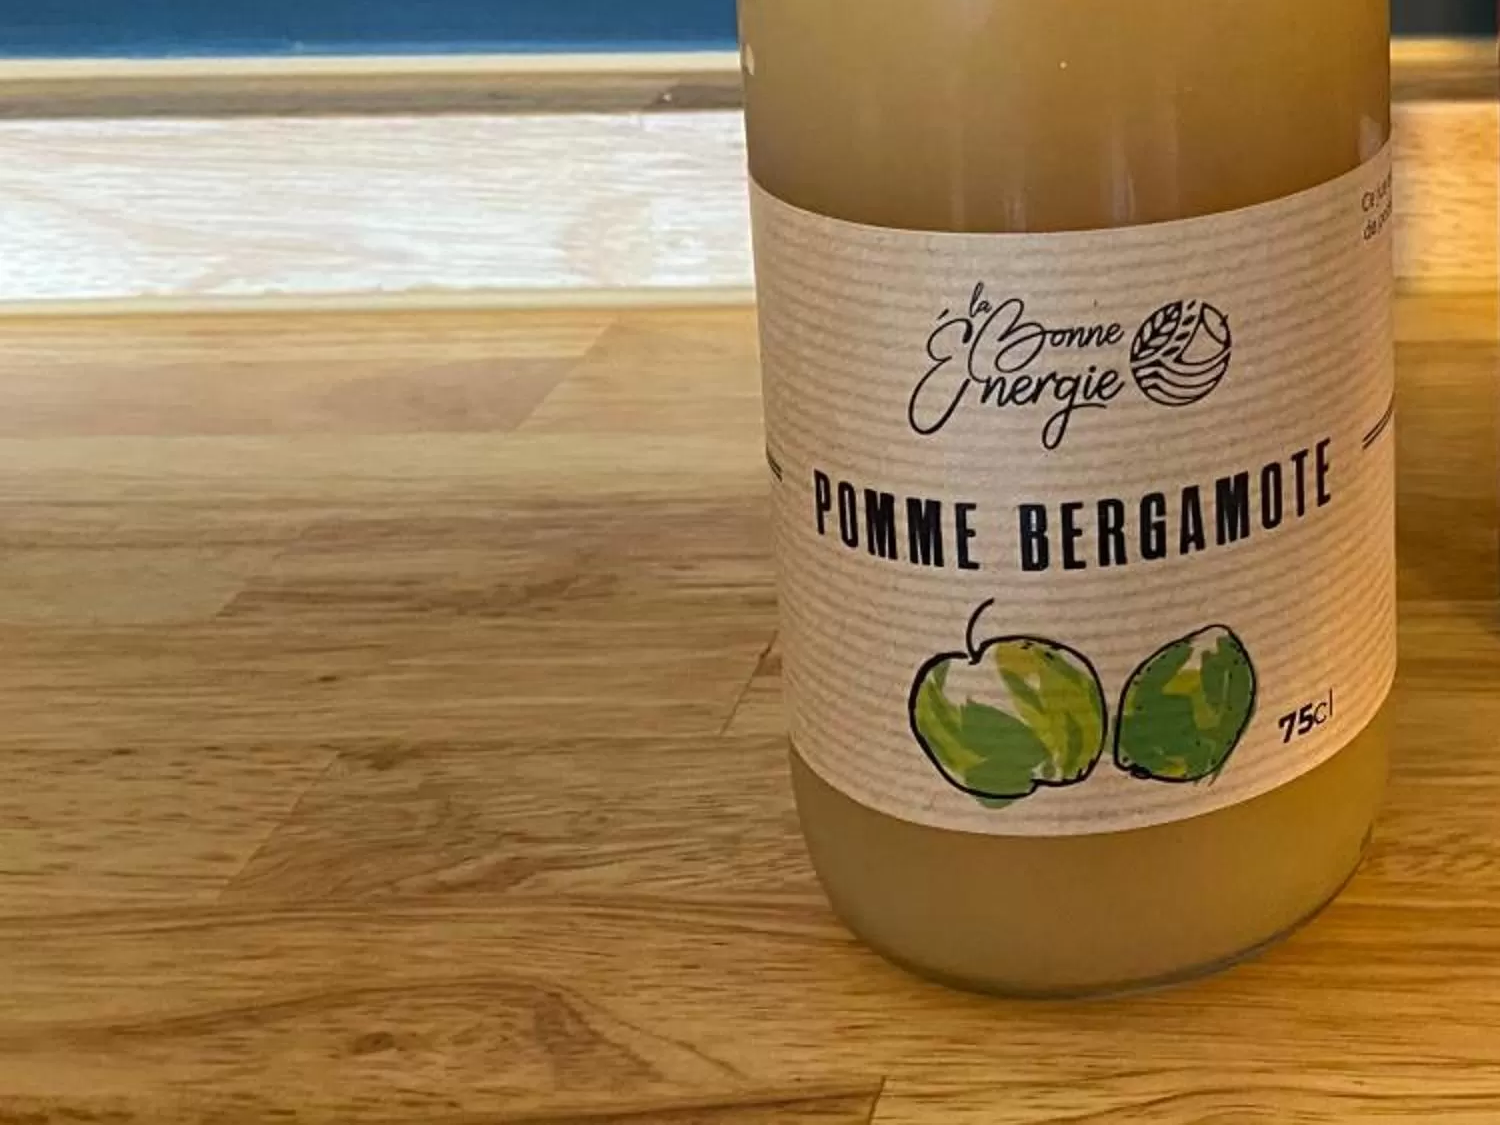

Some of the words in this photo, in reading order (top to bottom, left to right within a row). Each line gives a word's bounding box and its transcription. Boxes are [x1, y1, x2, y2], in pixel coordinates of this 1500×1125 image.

[967, 298, 1125, 383] Bonne
[969, 281, 992, 318] la
[908, 308, 1125, 450] Énergie
[813, 468, 980, 570] POMME
[1017, 437, 1332, 572] BERGAMOTE
[1278, 686, 1333, 744] 75cl
